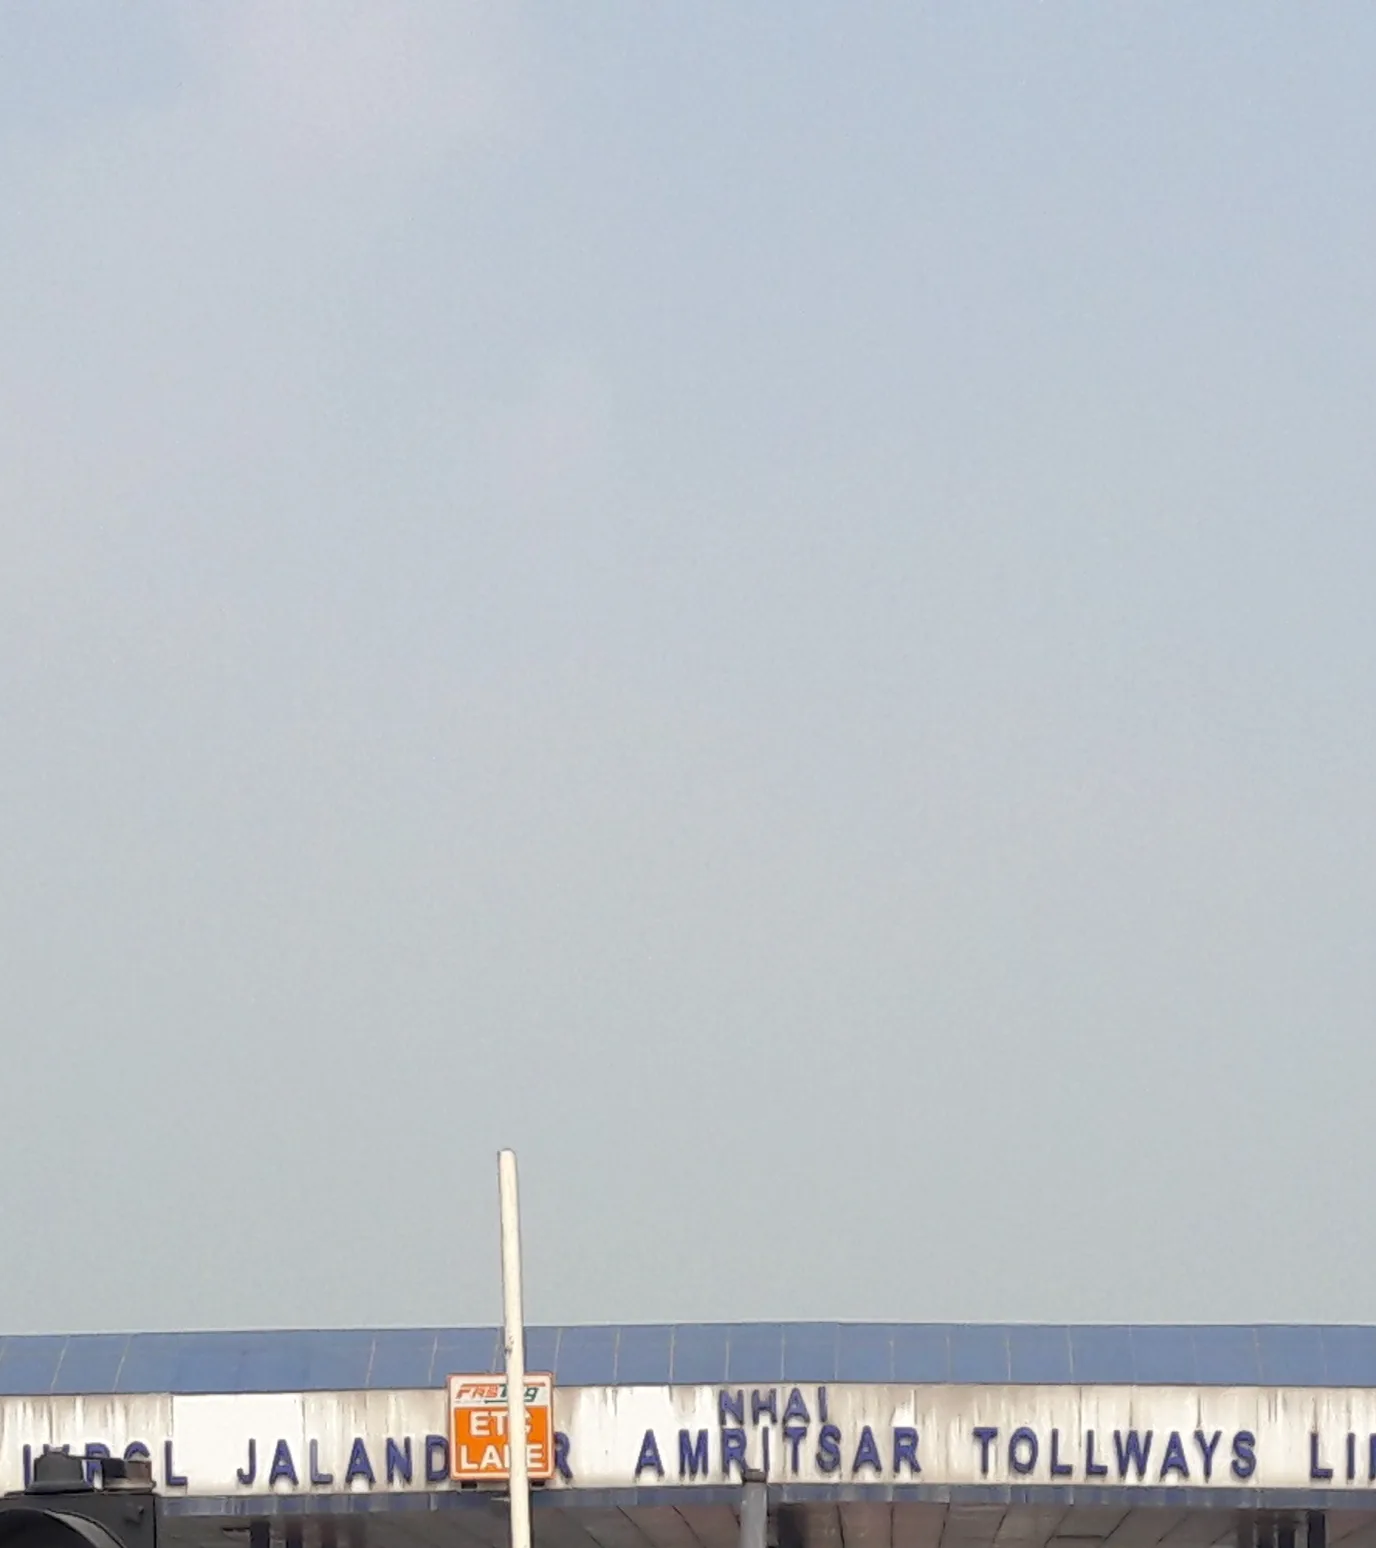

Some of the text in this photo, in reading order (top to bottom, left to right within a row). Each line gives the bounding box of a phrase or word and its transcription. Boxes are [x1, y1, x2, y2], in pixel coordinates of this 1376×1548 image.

[719, 1386, 829, 1426] NHAI
[237, 1432, 573, 1485] JALANDR
[634, 1425, 922, 1478] AMRITSAR
[973, 1427, 1257, 1480] TOLLWAYS
